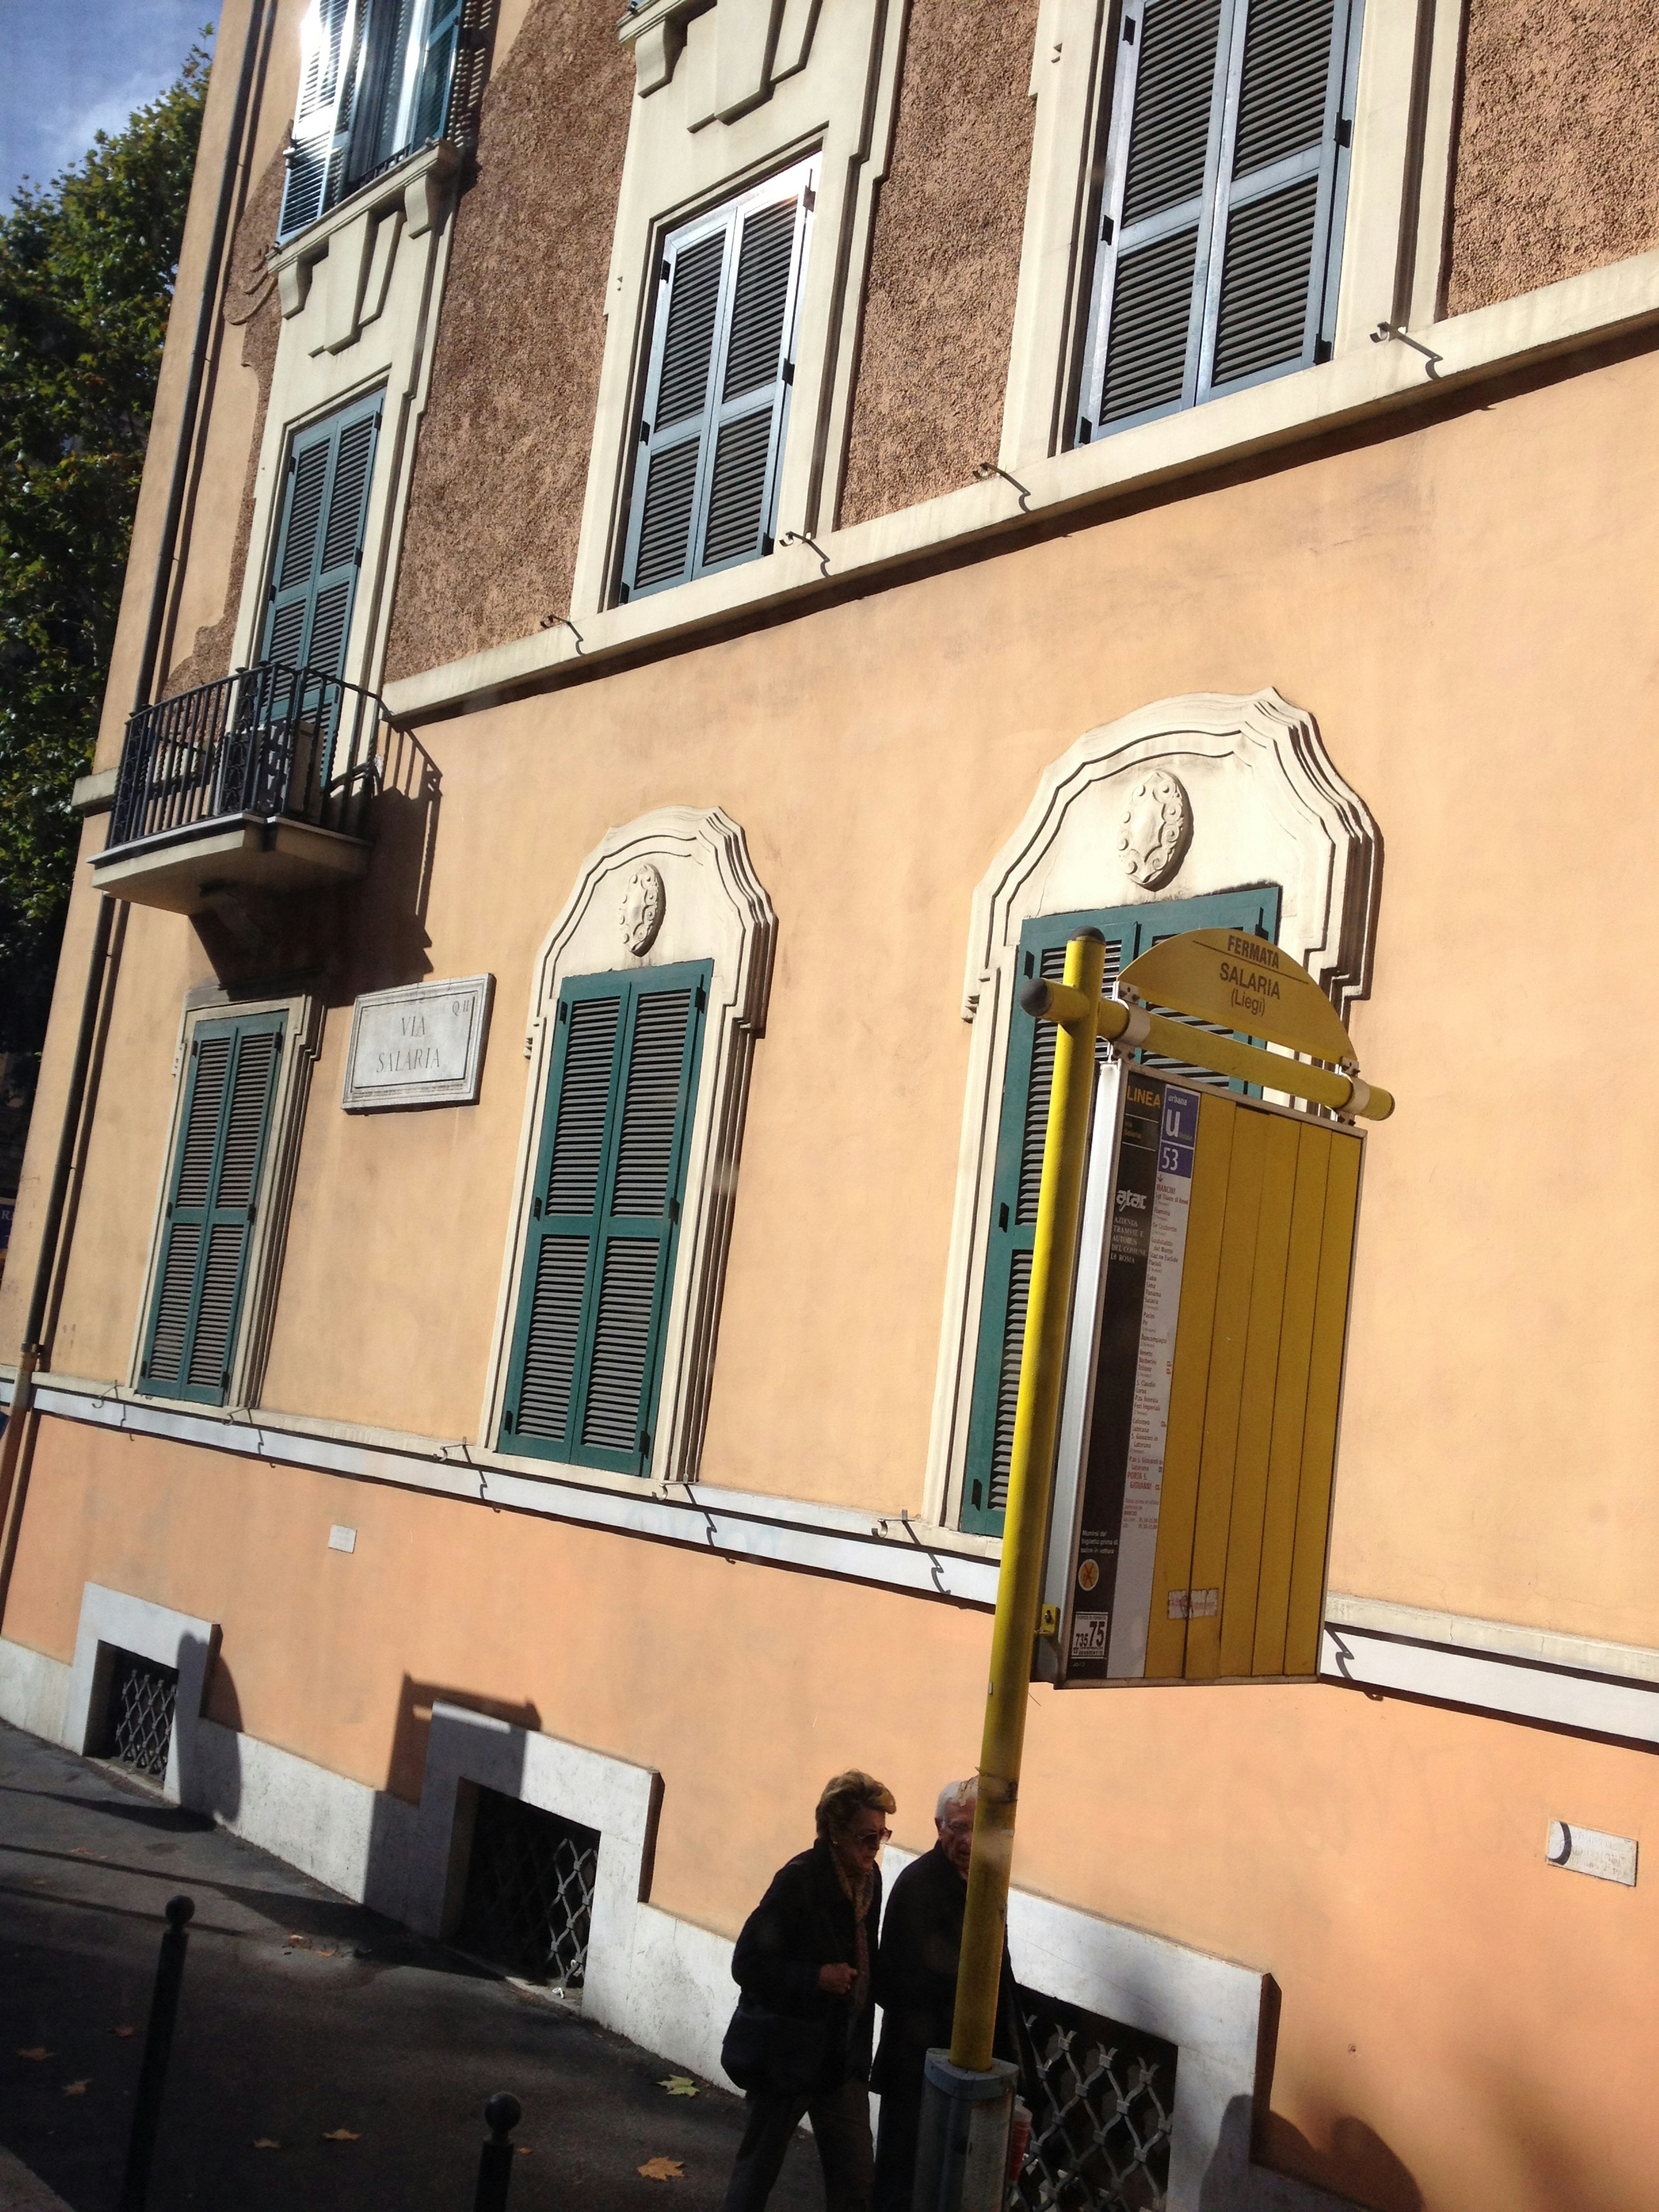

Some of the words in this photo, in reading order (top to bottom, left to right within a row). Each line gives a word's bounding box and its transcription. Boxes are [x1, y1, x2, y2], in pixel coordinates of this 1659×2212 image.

[1228, 935, 1279, 969] FERMATA
[1220, 963, 1280, 1000] SALARIA
[1231, 988, 1265, 1017] (Liegi)
[402, 1016, 426, 1036] VIA
[376, 1047, 440, 1073] SALARIA
[1126, 1086, 1160, 1108] LINEA
[1168, 1095, 1187, 1106] urbana
[1162, 1147, 1179, 1171] 53
[1116, 1189, 1147, 1212] atac
[1114, 1217, 1138, 1227] AZIENDA
[1119, 1255, 1135, 1264] ROMA
